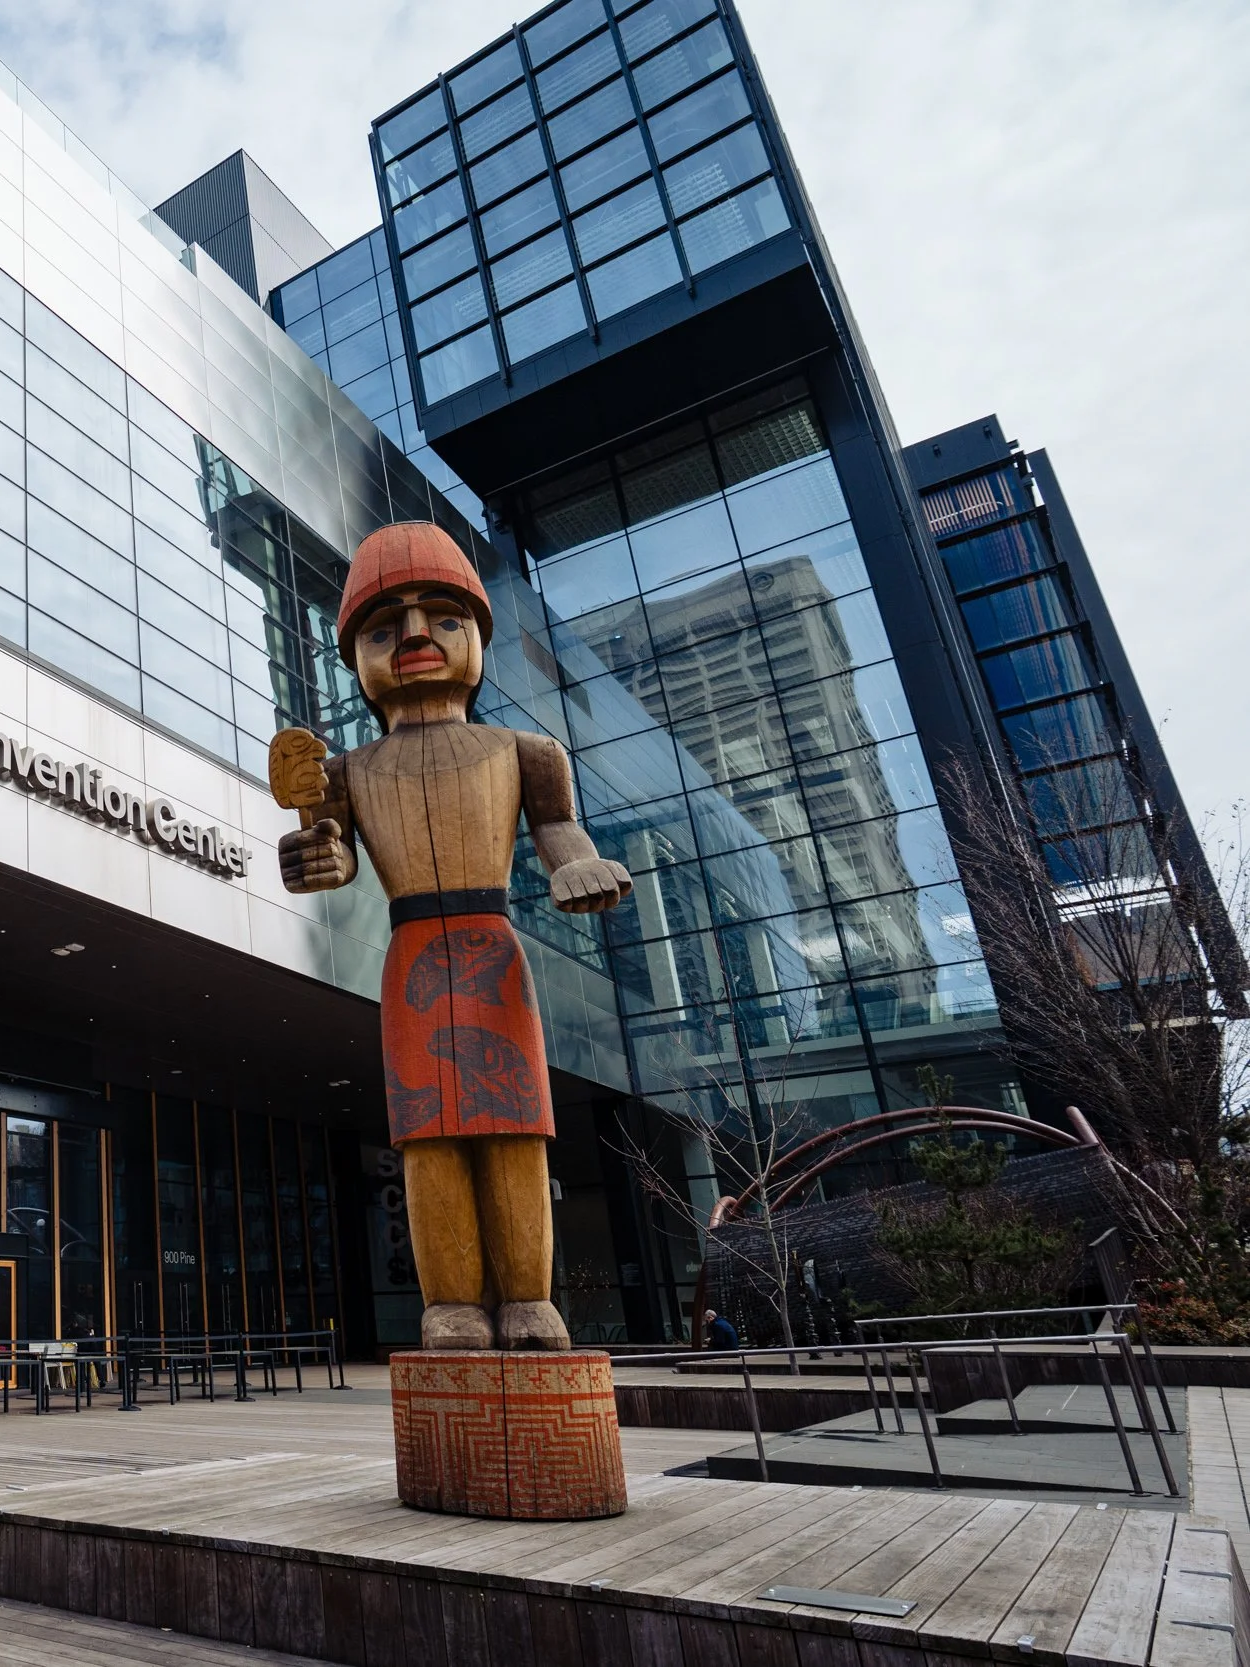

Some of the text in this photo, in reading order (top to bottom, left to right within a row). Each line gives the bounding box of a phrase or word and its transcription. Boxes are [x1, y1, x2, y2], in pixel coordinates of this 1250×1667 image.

[149, 797, 252, 878] Center
[164, 1250, 196, 1265] 900 Pine
